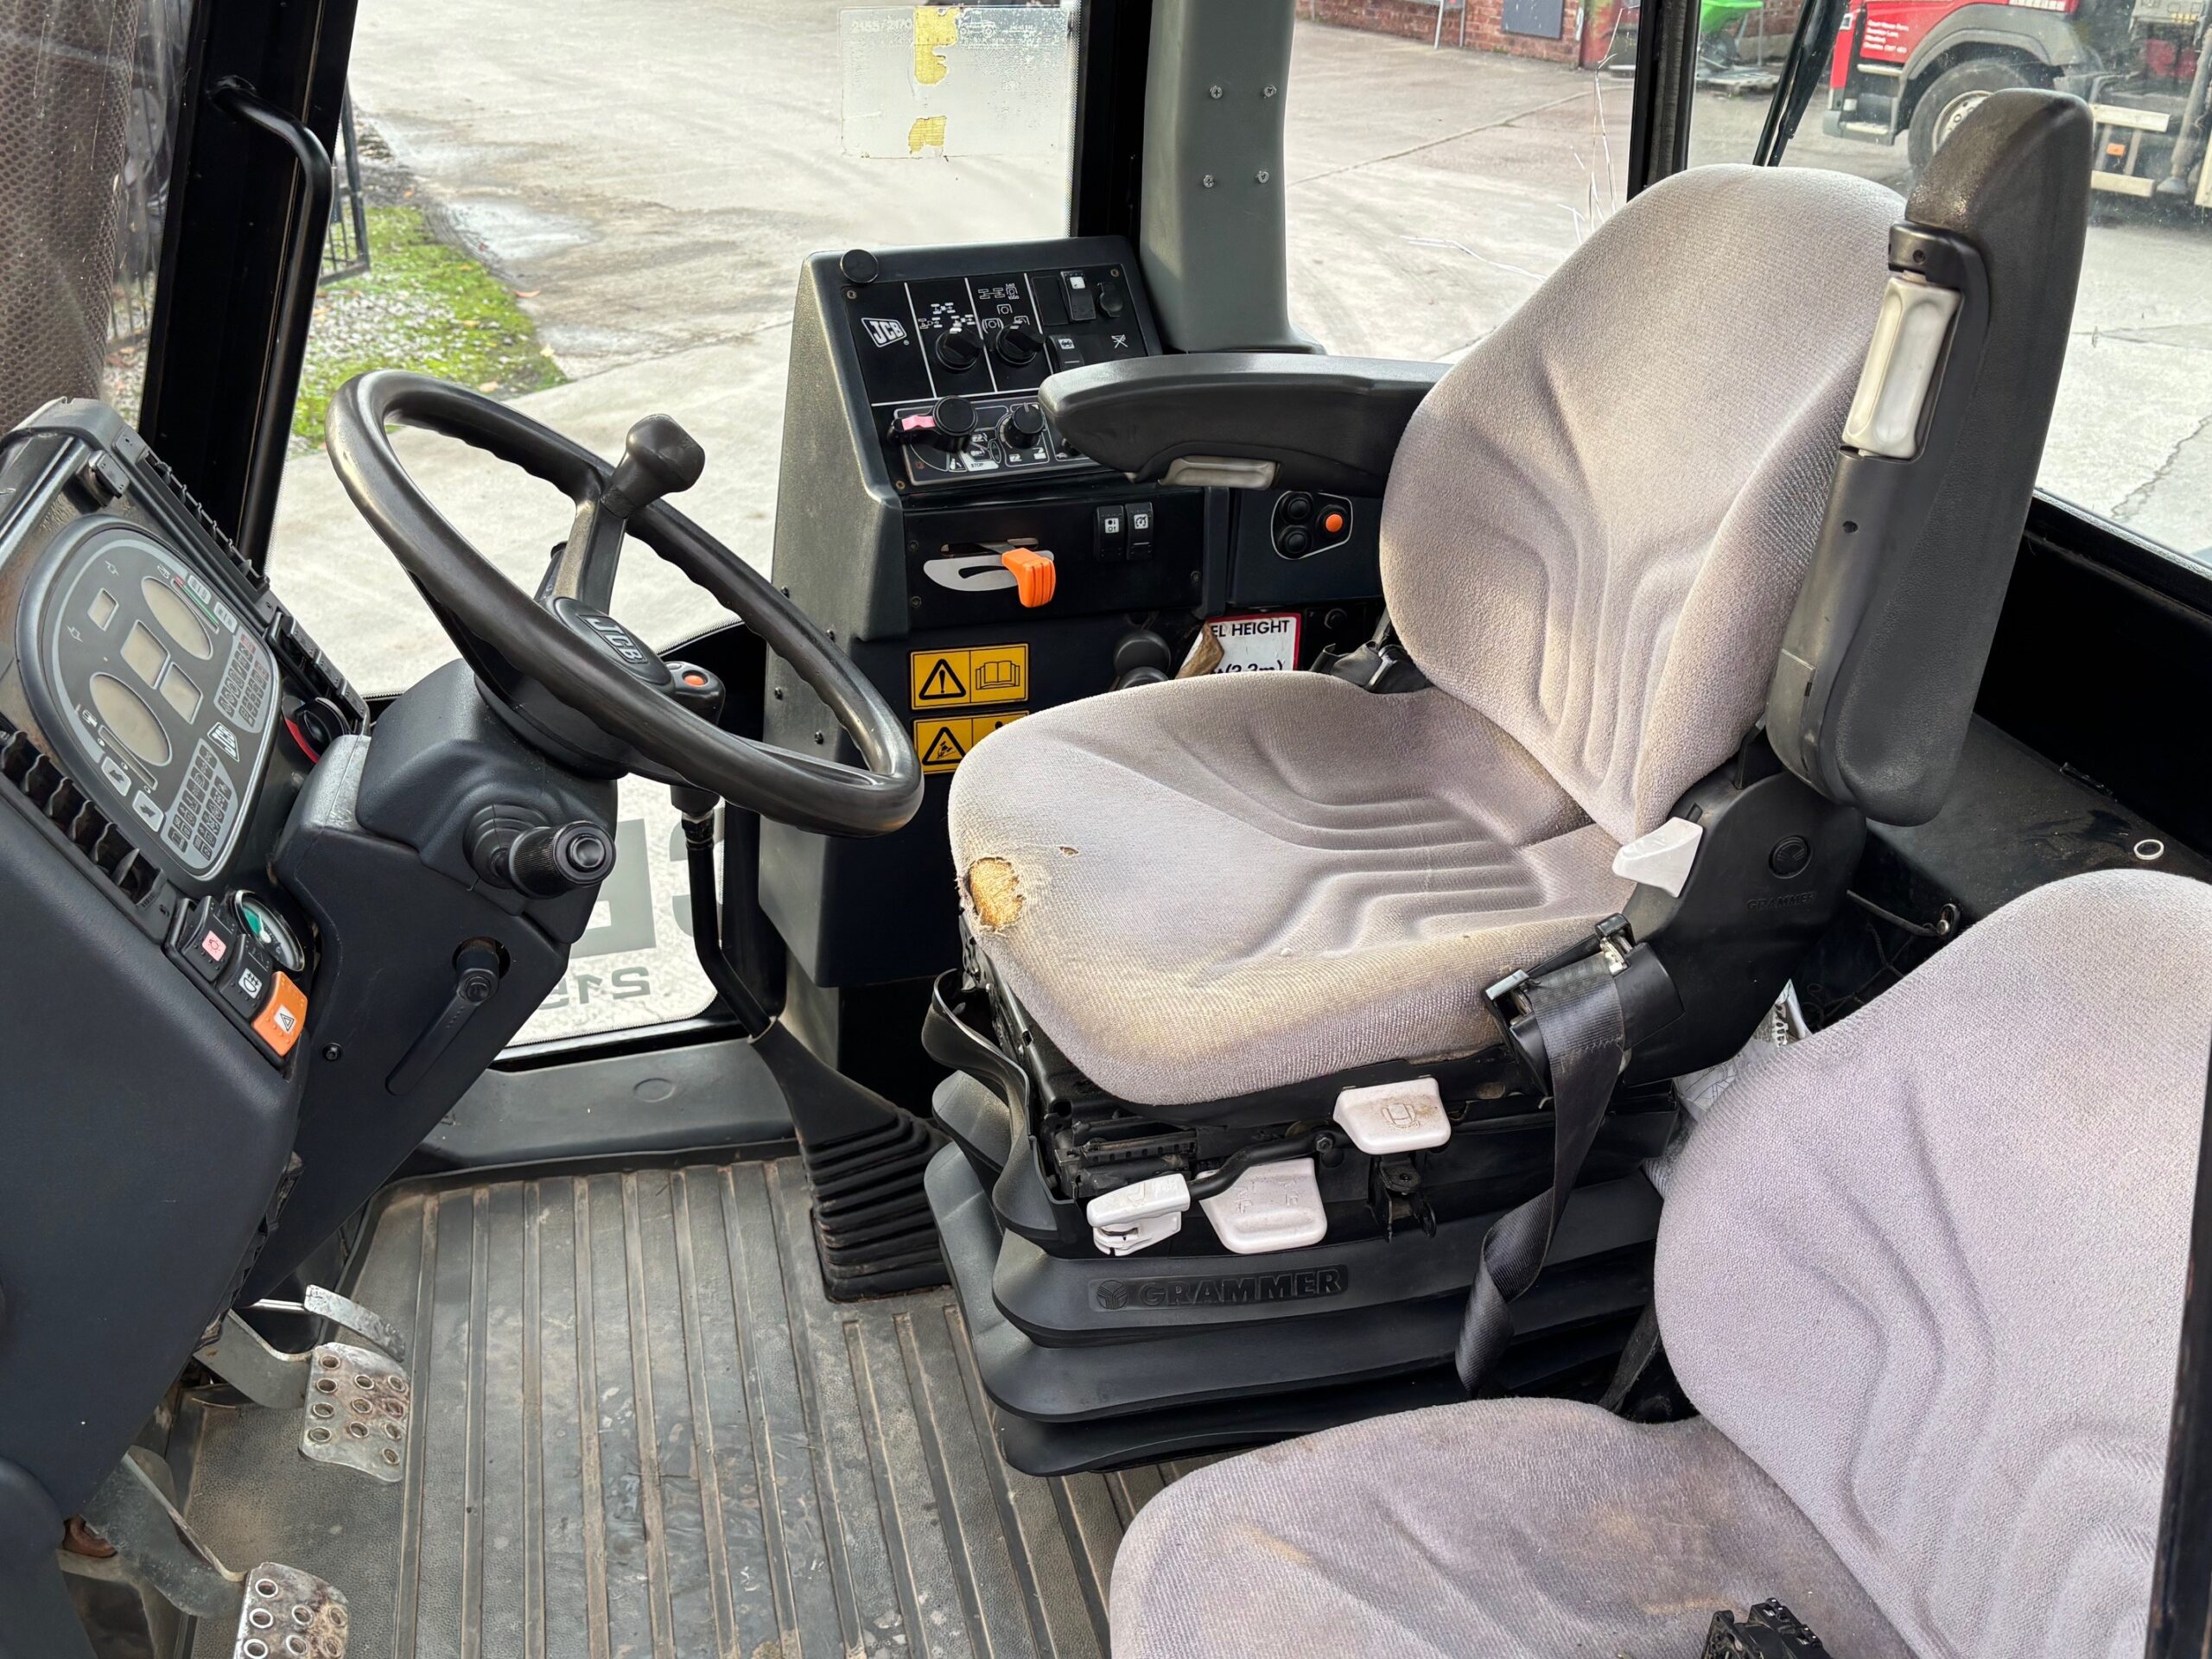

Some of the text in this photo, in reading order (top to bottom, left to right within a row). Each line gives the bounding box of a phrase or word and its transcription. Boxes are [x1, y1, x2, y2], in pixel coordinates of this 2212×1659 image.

[868, 321, 904, 344] JCB
[584, 617, 645, 662] JCB
[1231, 620, 1290, 637] HEIGHT
[211, 724, 237, 758] JCB
[1139, 1268, 1342, 1307] GRAMMER
